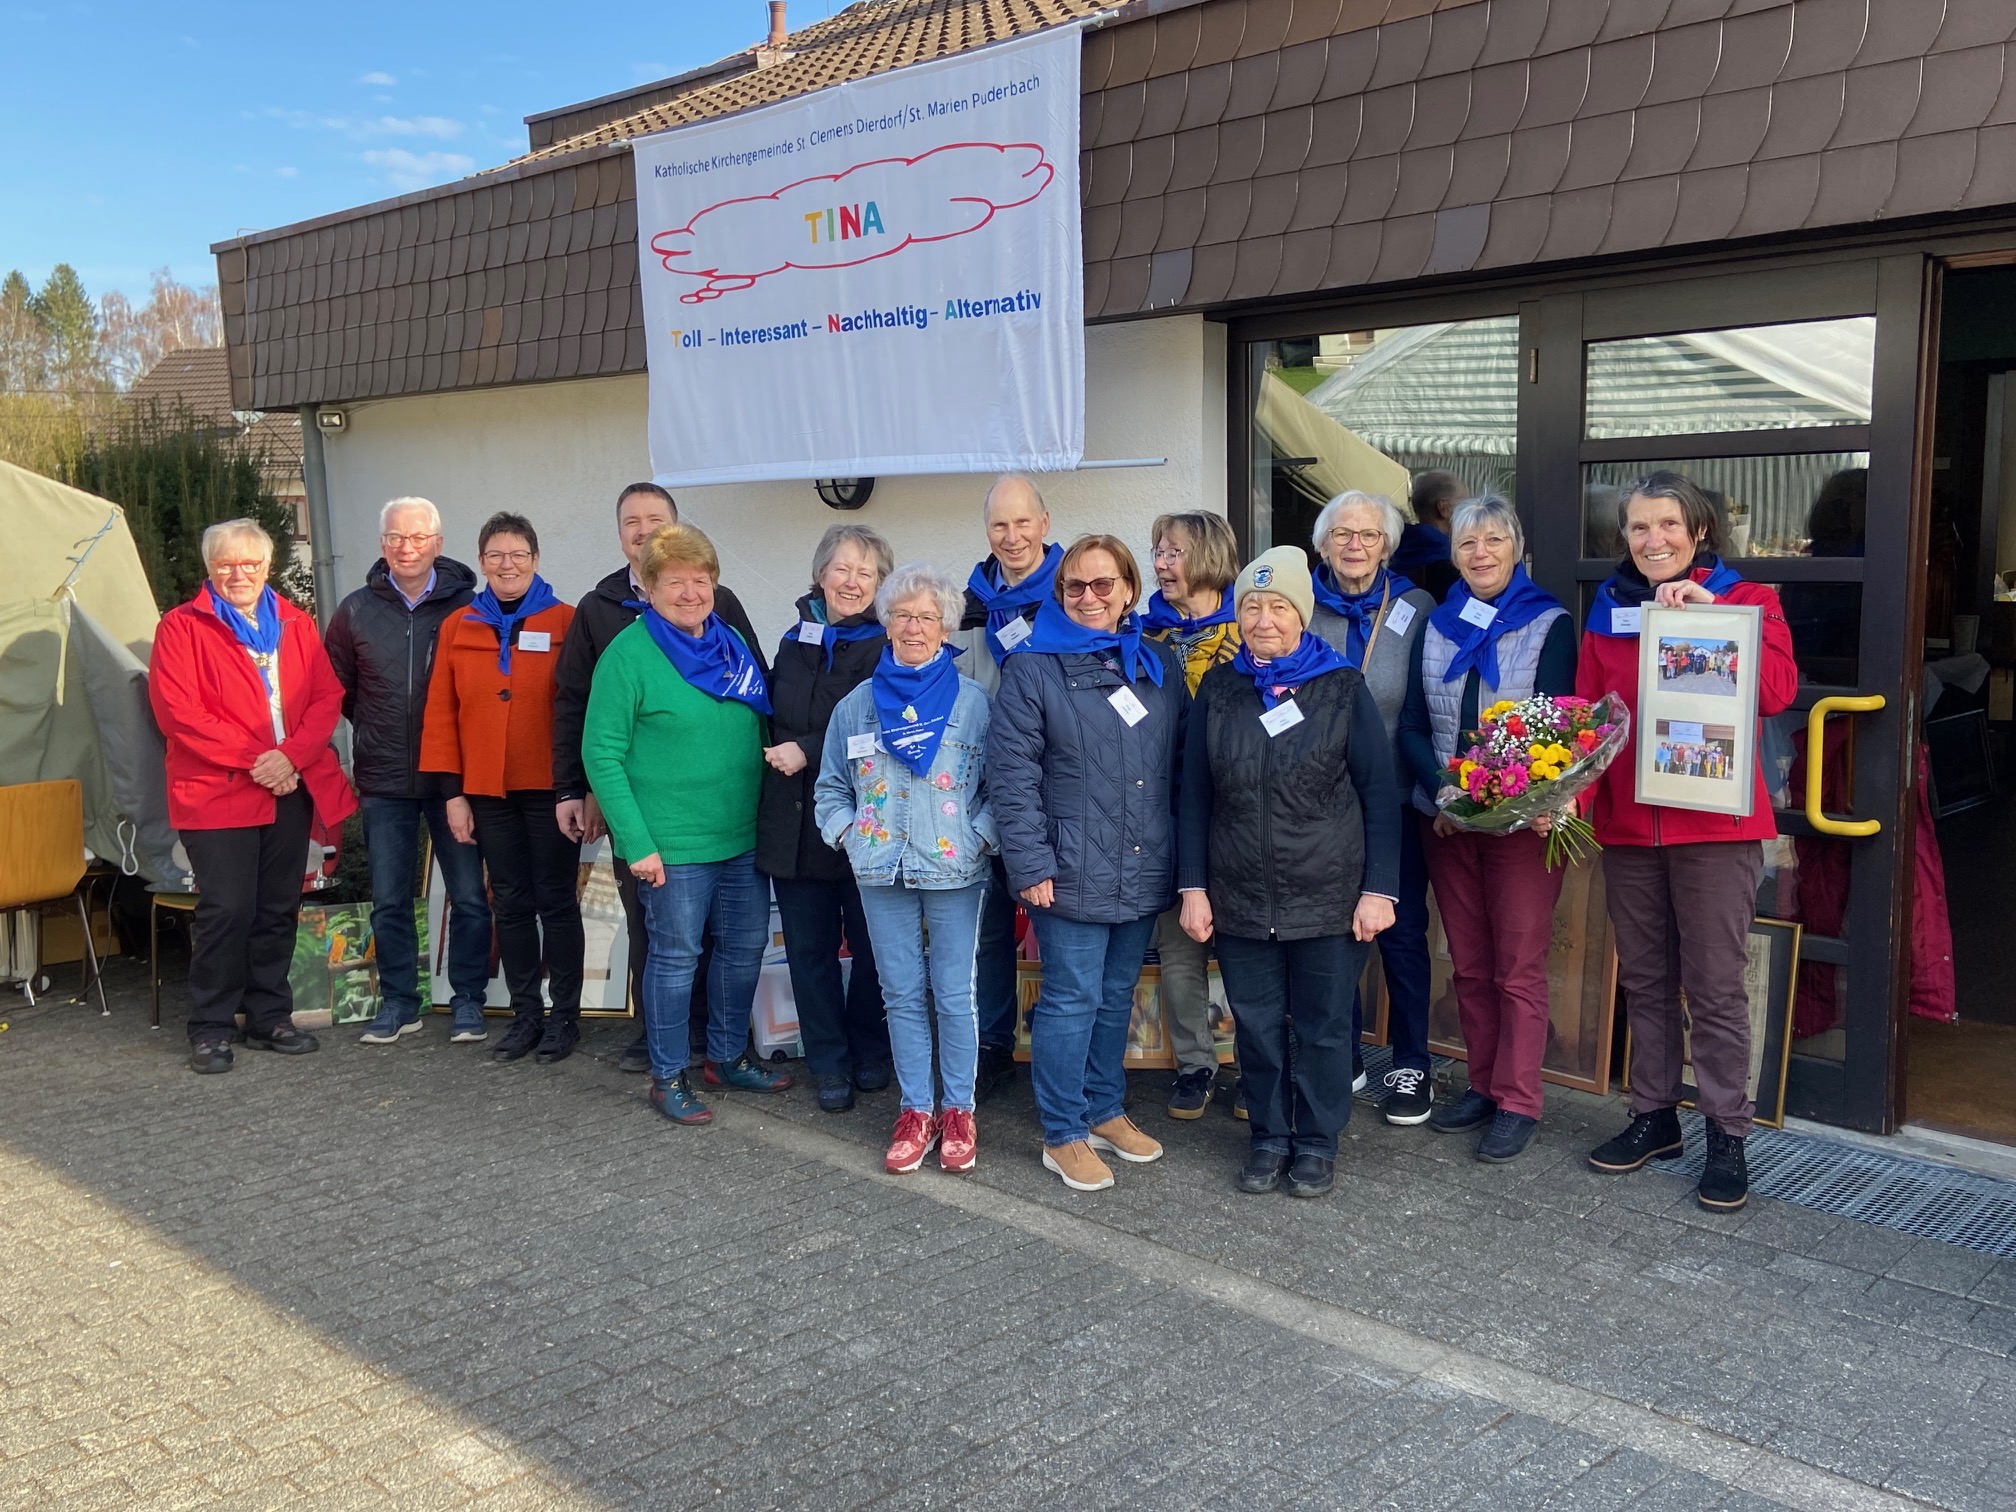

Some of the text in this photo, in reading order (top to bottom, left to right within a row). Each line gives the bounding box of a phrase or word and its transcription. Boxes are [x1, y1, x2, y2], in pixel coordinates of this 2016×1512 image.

[655, 160, 710, 178] Katholische
[711, 140, 794, 170] Kirchengemeinde
[810, 123, 853, 146] Clemens
[928, 98, 968, 118] Marien
[972, 74, 1040, 109] Puderbach
[804, 201, 885, 244] TINA
[671, 329, 702, 348] Toll
[720, 319, 808, 346] Interessant
[945, 289, 1041, 320] Alternativ
